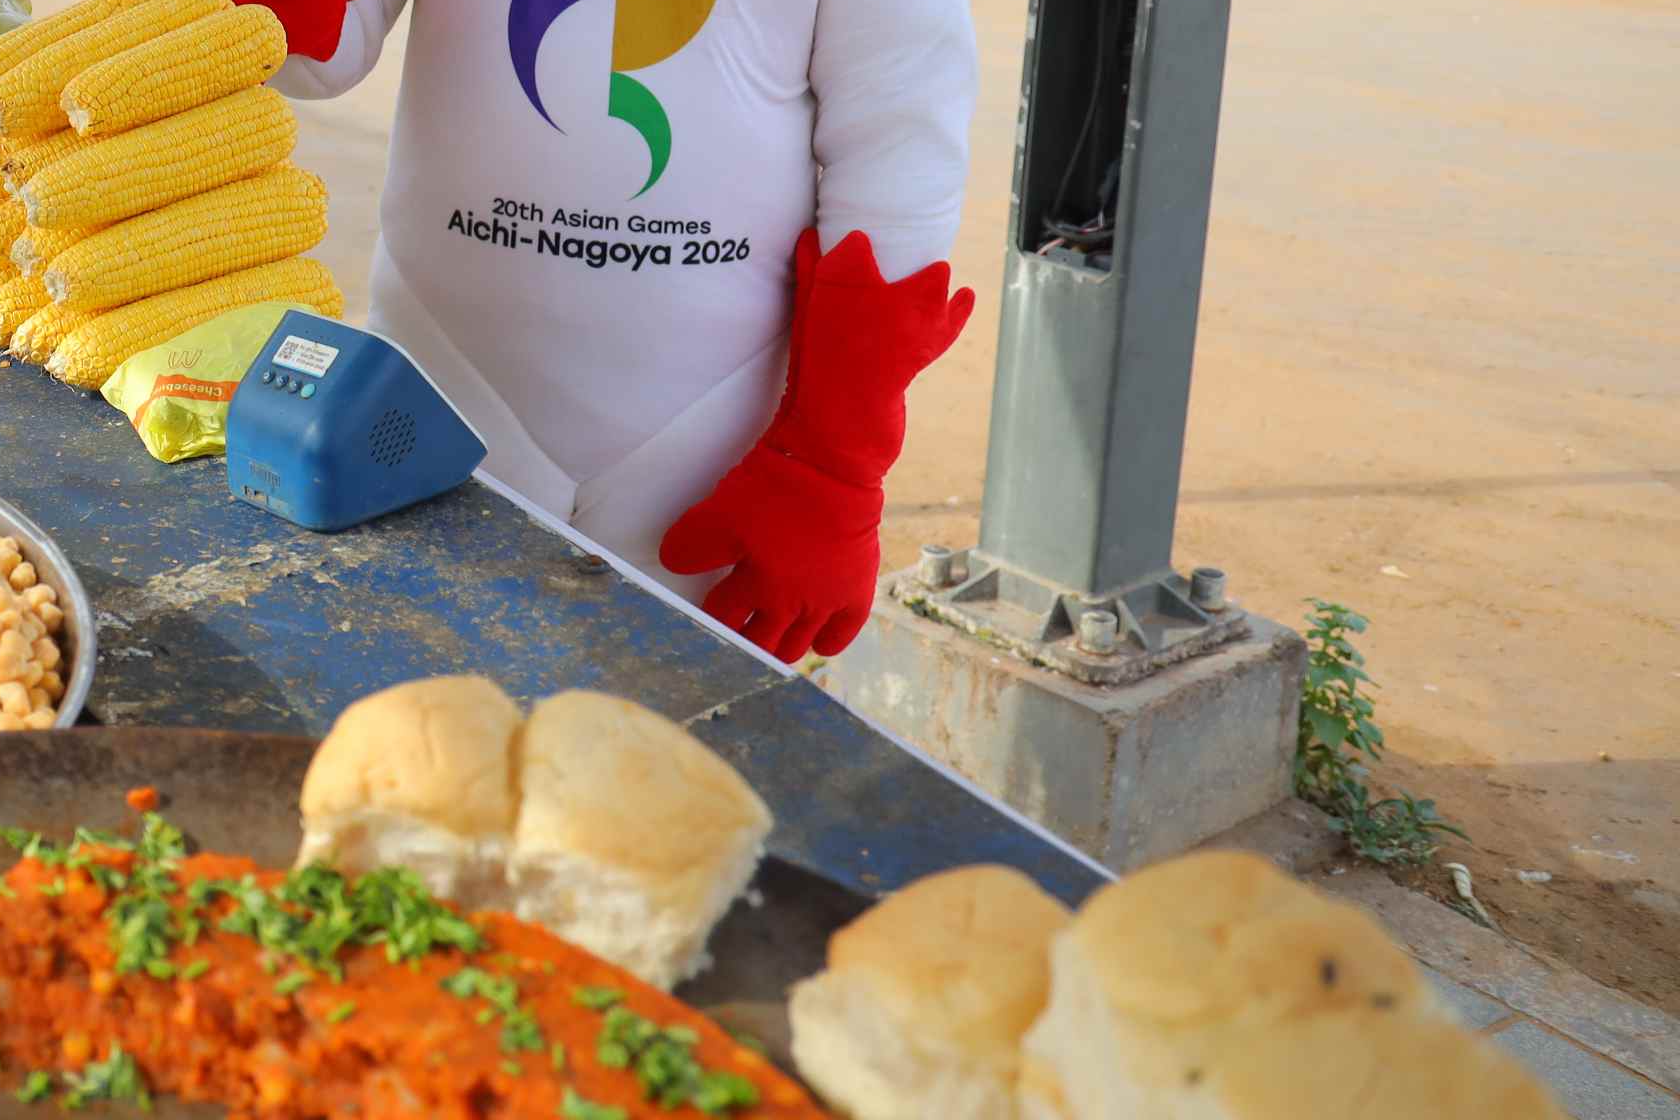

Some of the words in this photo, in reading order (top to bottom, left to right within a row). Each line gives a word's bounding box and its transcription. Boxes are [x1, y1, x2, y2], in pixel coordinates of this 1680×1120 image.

[447, 209, 672, 272] Aichi-Nagoya
[681, 238, 750, 266] 2026
[492, 197, 544, 223] 20th
[551, 208, 619, 232] Asian
[627, 215, 712, 235] Games
